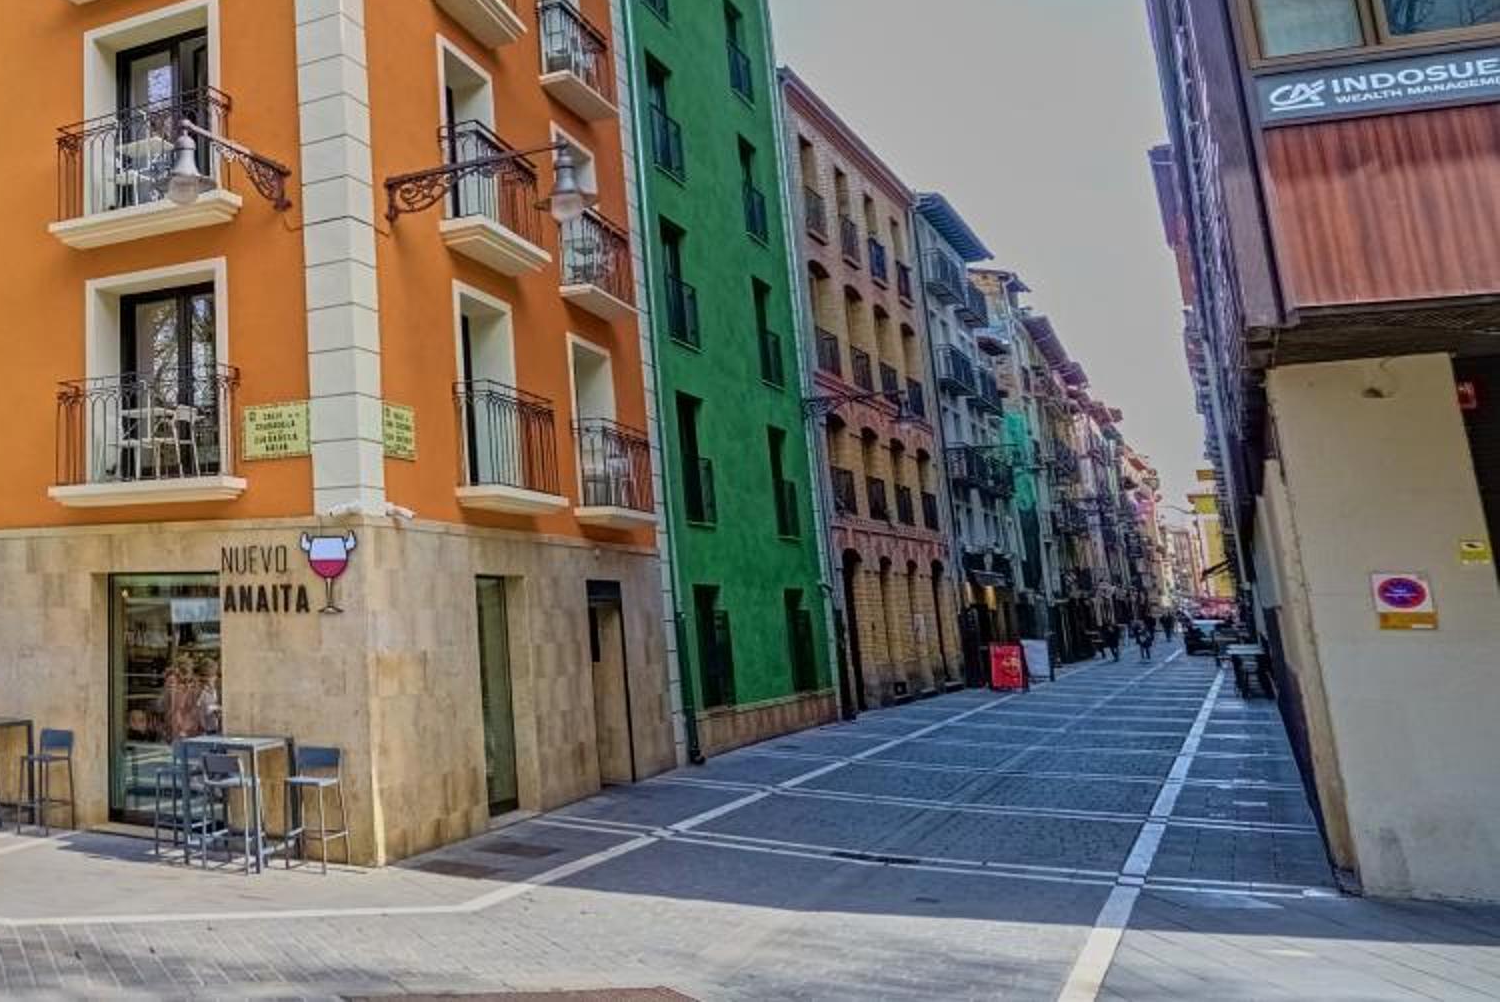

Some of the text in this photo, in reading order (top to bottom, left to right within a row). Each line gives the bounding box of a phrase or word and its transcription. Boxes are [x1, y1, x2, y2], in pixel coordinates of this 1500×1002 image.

[1336, 89, 1404, 104] WEALTH
[221, 545, 287, 575] NUEVO
[223, 583, 310, 613] ANAITA
